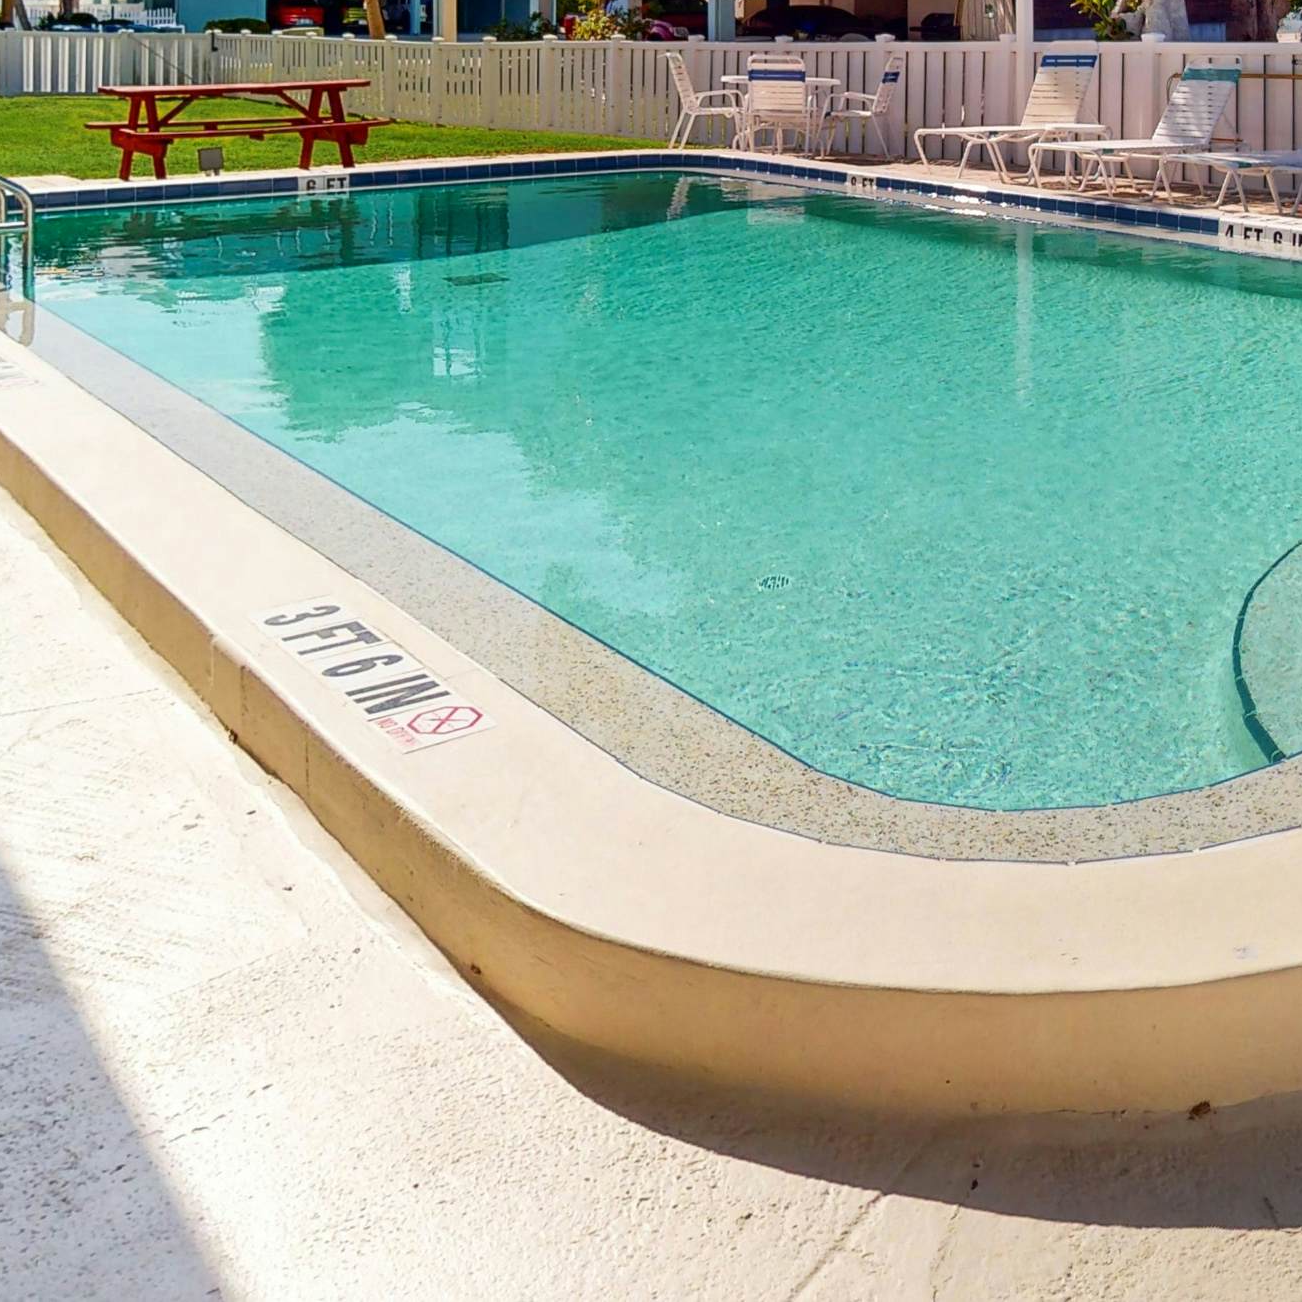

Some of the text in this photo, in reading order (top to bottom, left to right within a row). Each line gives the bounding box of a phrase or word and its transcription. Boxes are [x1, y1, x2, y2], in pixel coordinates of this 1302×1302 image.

[326, 177, 346, 189] FT
[1243, 227, 1263, 241] FT
[264, 605, 451, 715] 3 FT 6 IN
